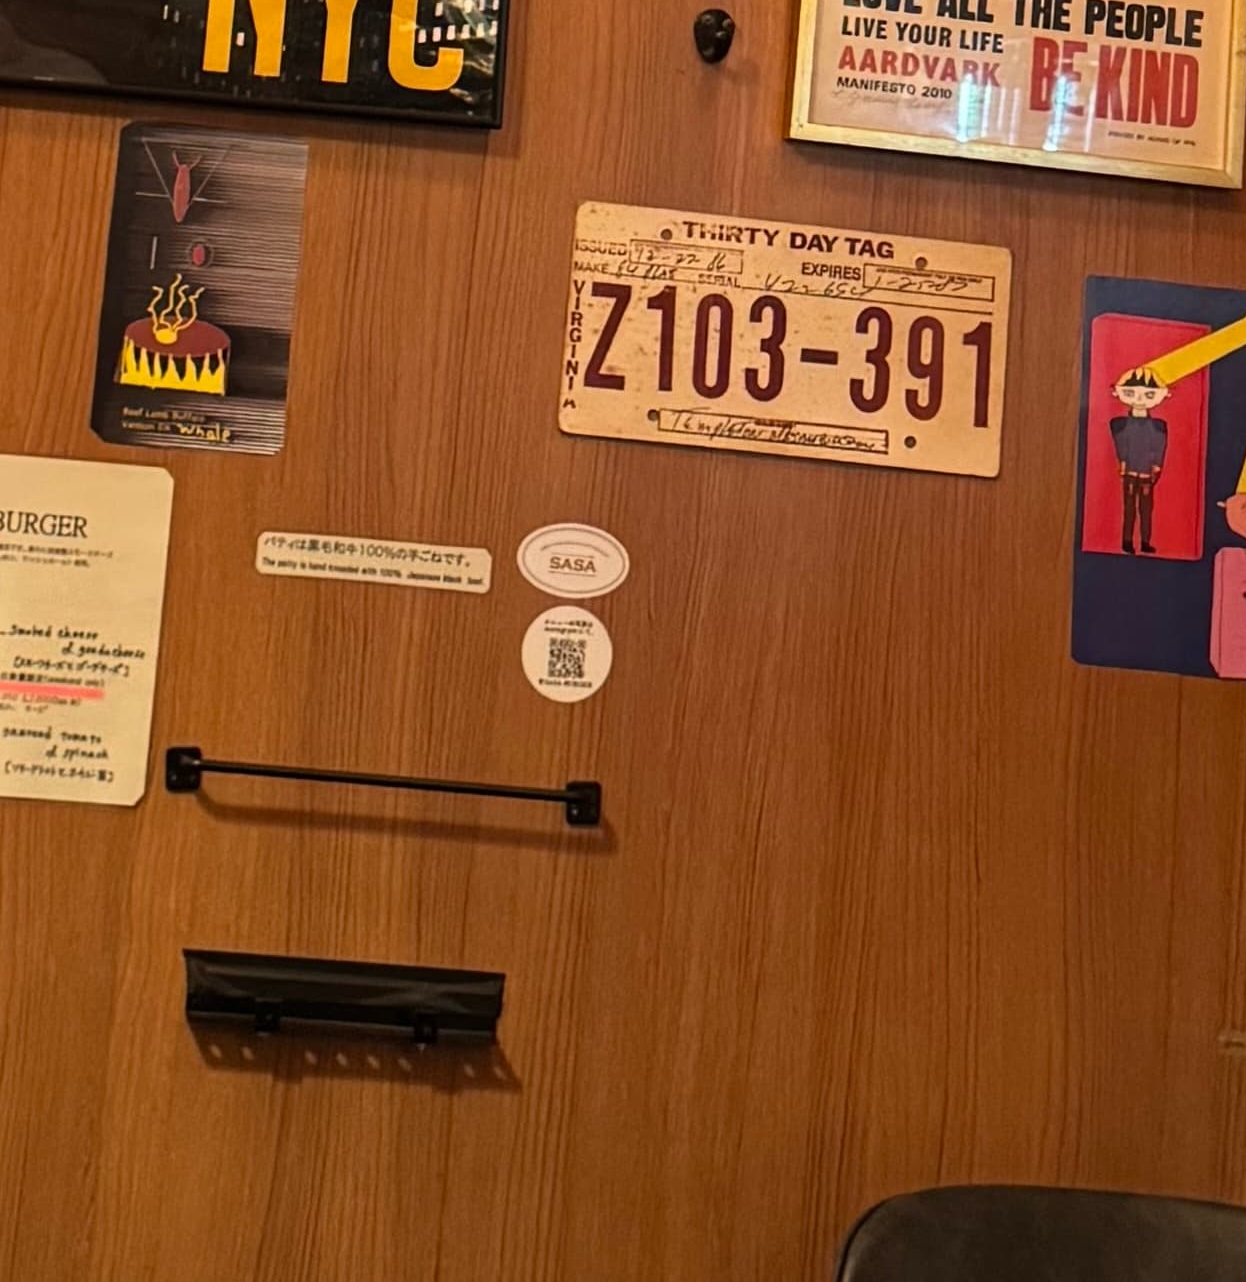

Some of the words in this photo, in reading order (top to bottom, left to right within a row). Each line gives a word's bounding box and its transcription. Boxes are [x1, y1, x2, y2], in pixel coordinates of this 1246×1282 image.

[841, 16, 888, 40] LIVE
[895, 21, 952, 49] YOUR
[958, 29, 1004, 54] LIFE
[837, 77, 916, 97] MANIFESTO
[922, 86, 953, 101] 2010
[838, 45, 1001, 88] AARDVARK
[1029, 35, 1088, 116] BE
[1094, 44, 1200, 129] KIND
[575, 238, 627, 257] ISSUED
[801, 261, 862, 281] EXPIRES
[682, 219, 780, 248] THIRTY
[788, 232, 839, 254] DAY
[844, 237, 895, 260] TAG
[573, 261, 609, 274] MAKE
[562, 279, 587, 410] VIRGINIA
[583, 281, 994, 429] Z103-391
[550, 556, 597, 573] SASA
